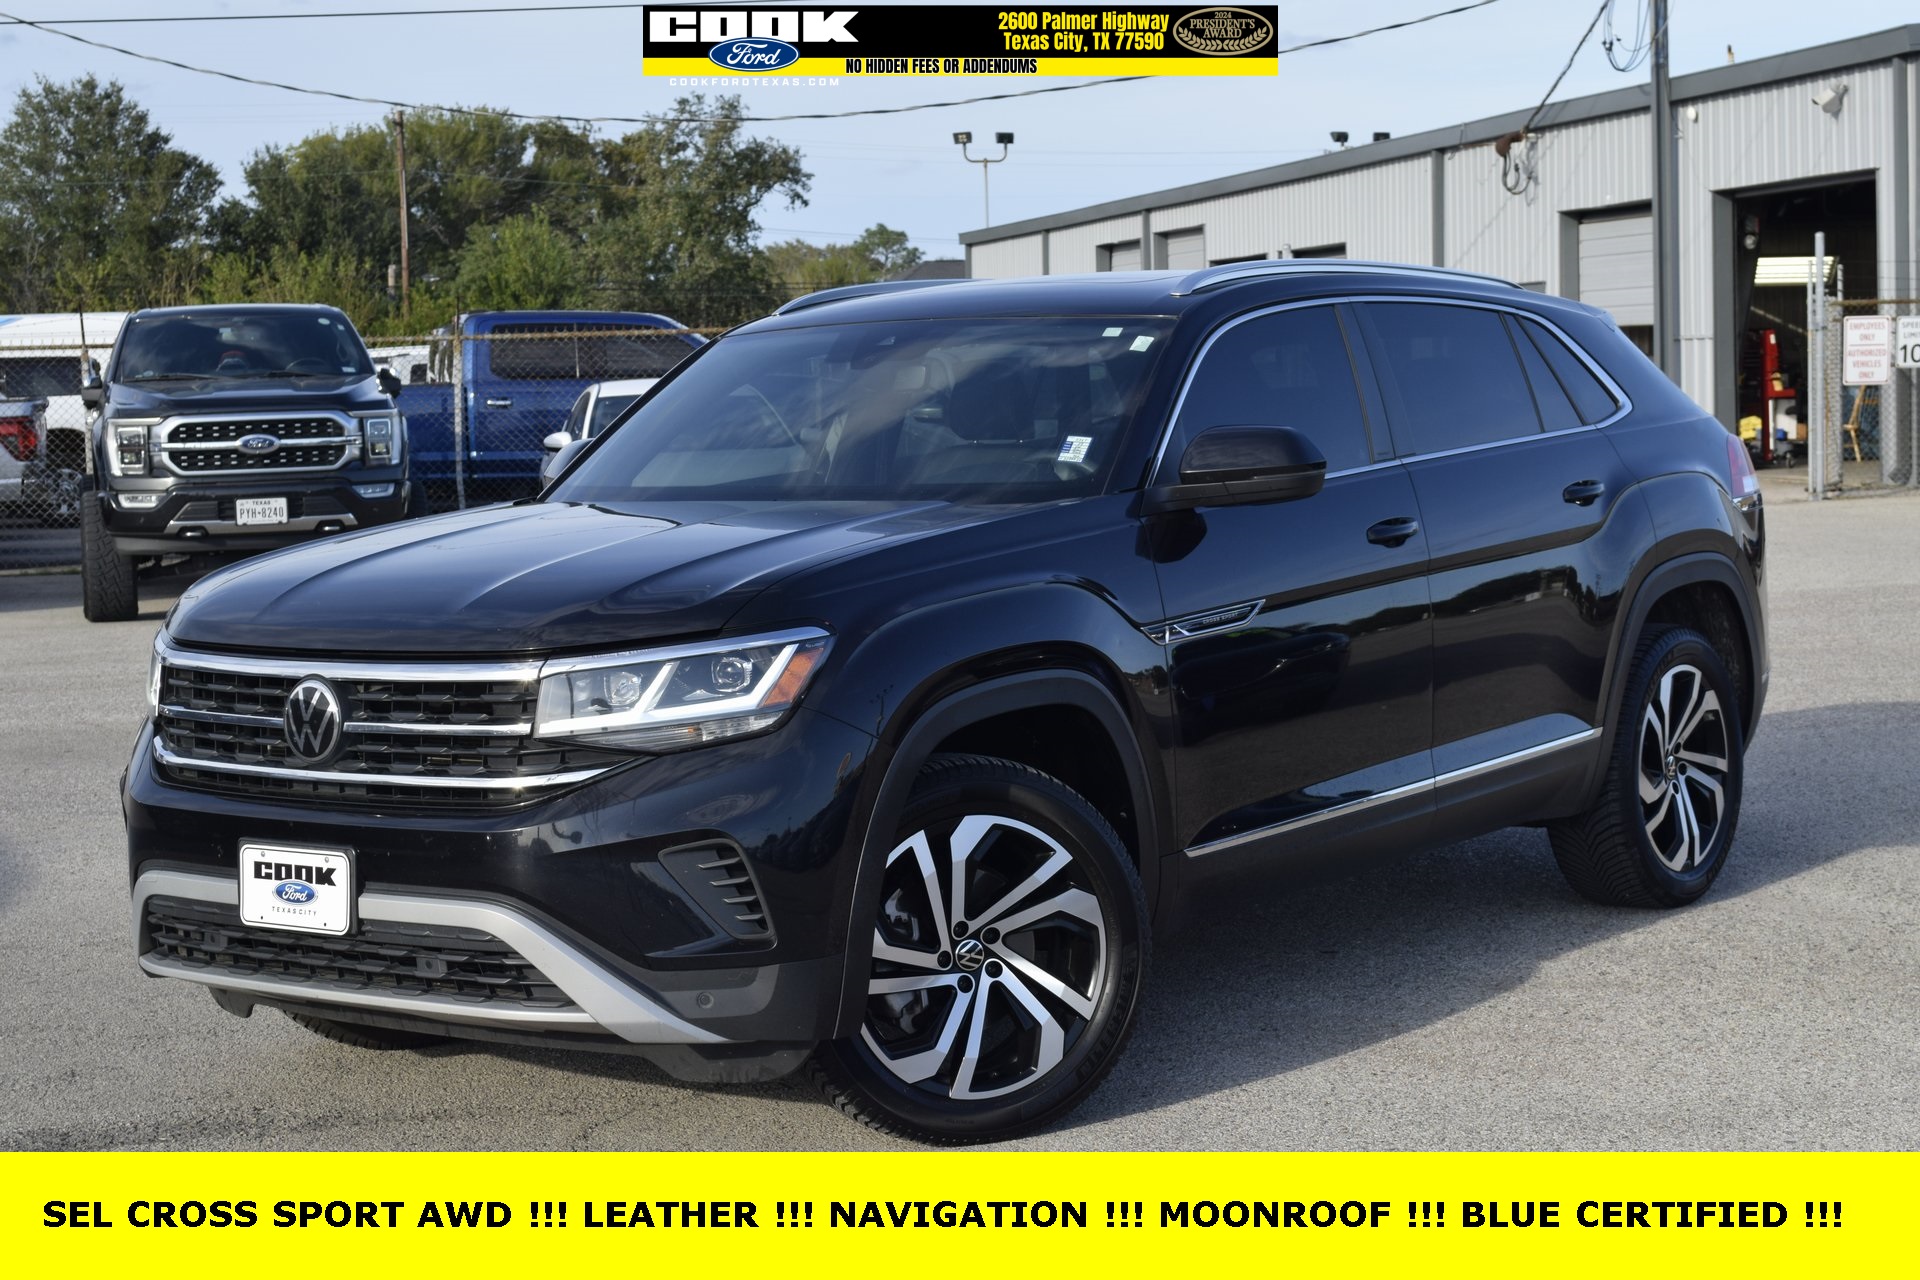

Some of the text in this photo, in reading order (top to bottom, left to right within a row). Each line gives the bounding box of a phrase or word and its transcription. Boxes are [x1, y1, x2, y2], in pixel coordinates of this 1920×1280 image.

[1849, 321, 1886, 330] EMPLOYEES
[1847, 348, 1887, 357] AUTHORIZED
[1900, 344, 1920, 363] 10
[1852, 360, 1881, 368] VEHICLES
[1858, 371, 1874, 379] ONLY
[253, 860, 337, 887] COOK
[282, 884, 307, 901] Ford
